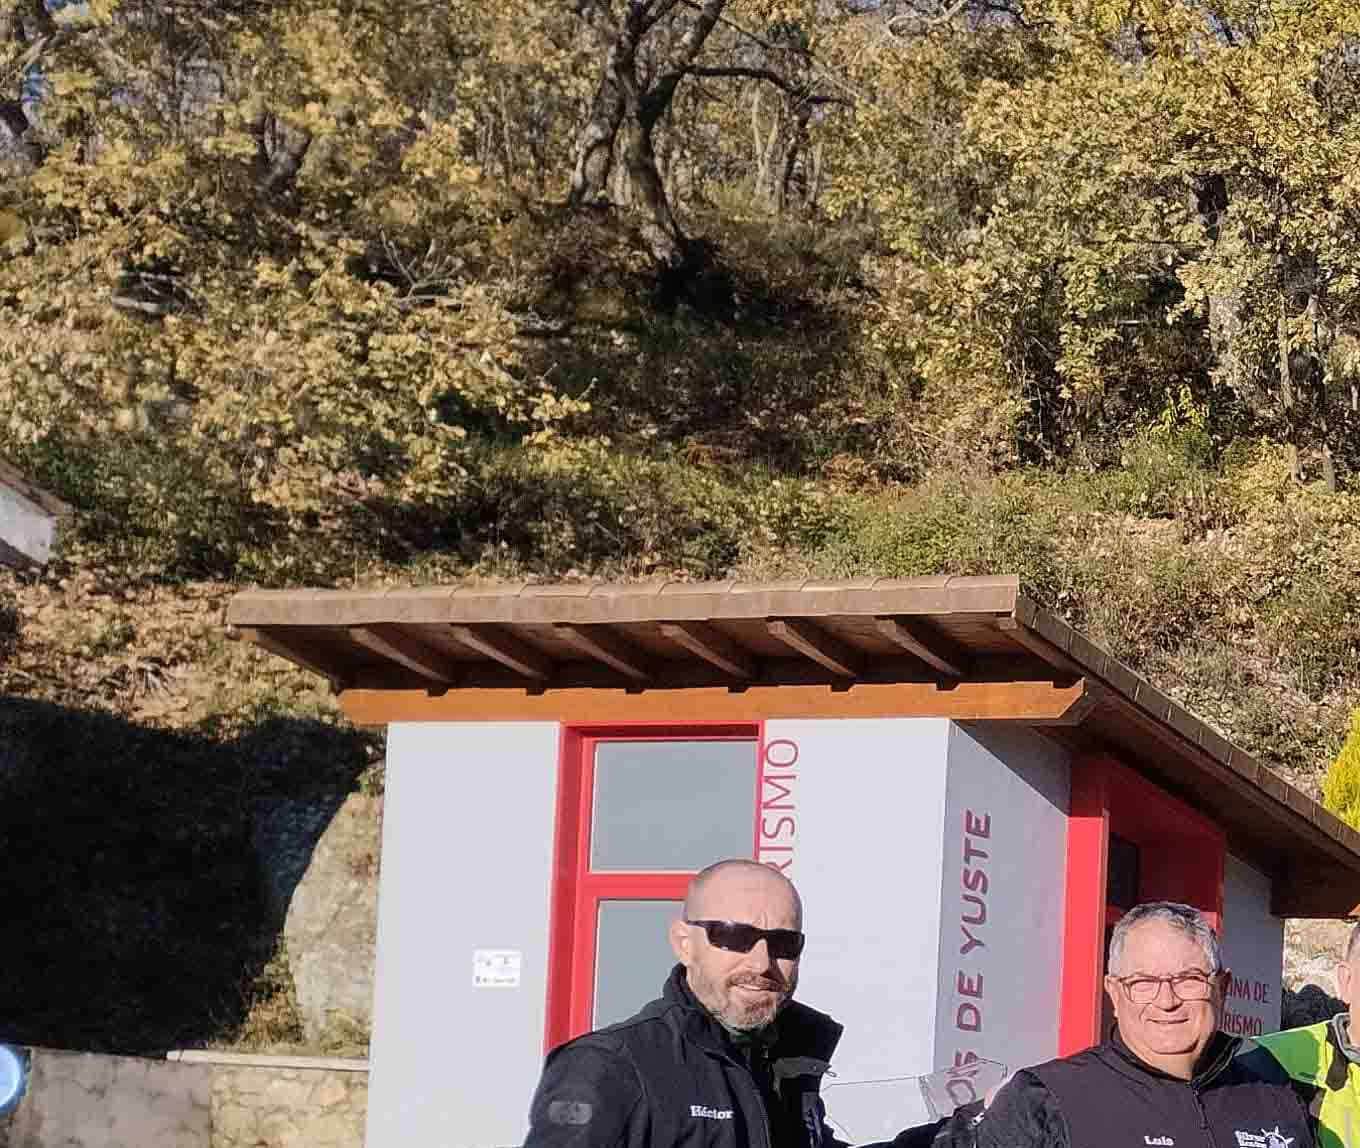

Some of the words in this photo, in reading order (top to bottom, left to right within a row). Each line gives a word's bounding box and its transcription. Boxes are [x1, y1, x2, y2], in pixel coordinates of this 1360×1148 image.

[960, 808, 992, 955] YUSTE
[956, 970, 984, 1032] DE
[1254, 981, 1273, 1004] DE
[1219, 1012, 1264, 1036] RISMO
